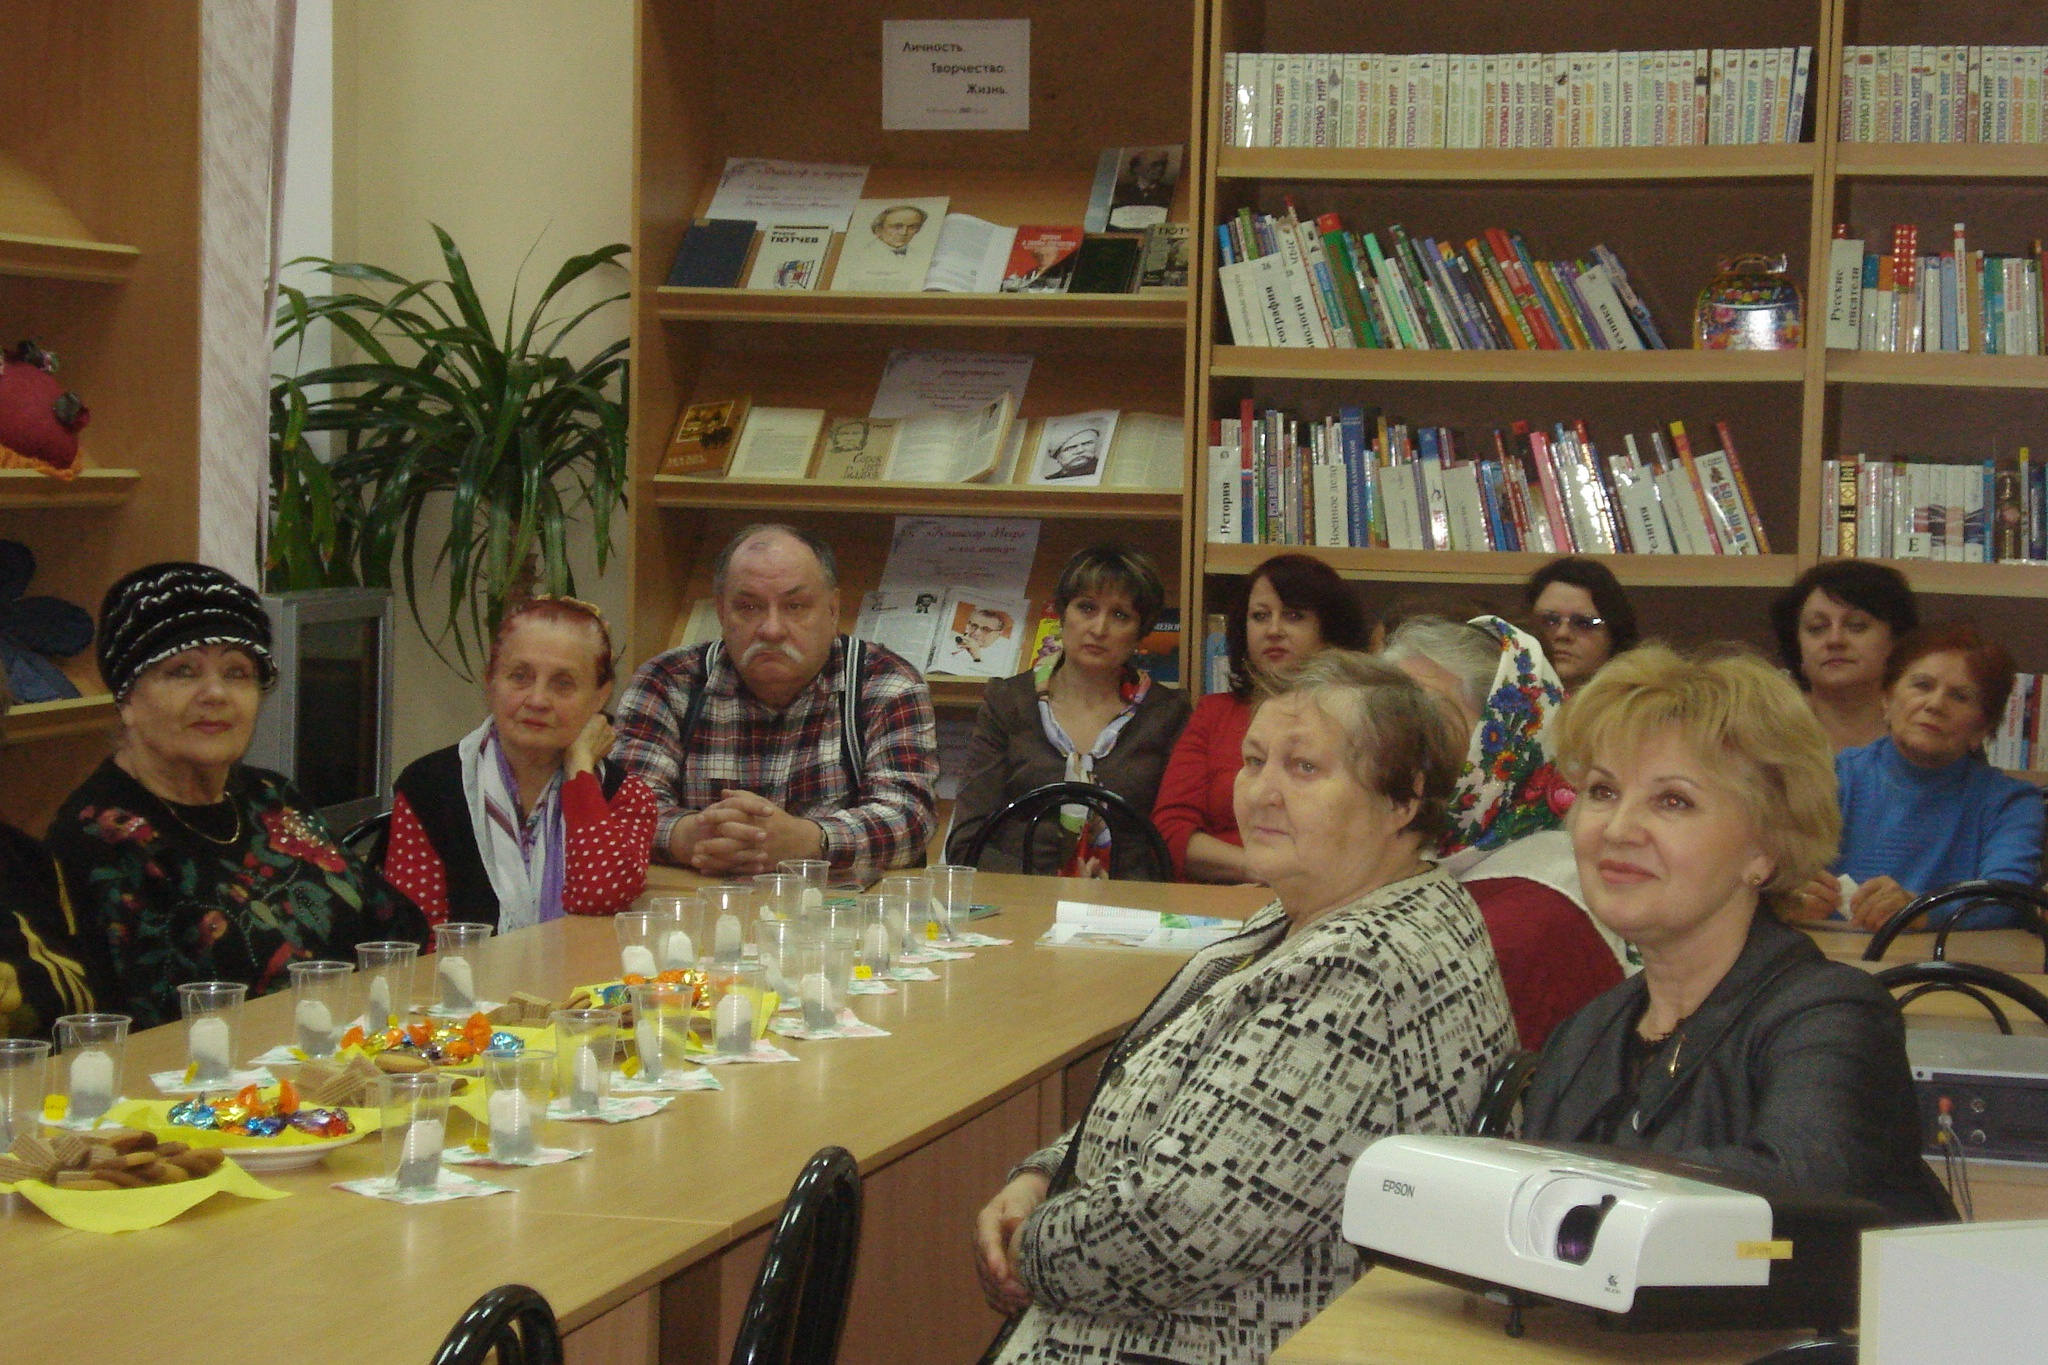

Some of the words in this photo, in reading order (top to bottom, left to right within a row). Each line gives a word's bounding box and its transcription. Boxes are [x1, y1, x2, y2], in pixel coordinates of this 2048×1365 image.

[1265, 286, 1286, 345] еография
[1830, 269, 1845, 321] Русские
[1220, 482, 1232, 535] История
[1640, 506, 1658, 553] елигия
[1382, 1179, 1416, 1198] EPSON
